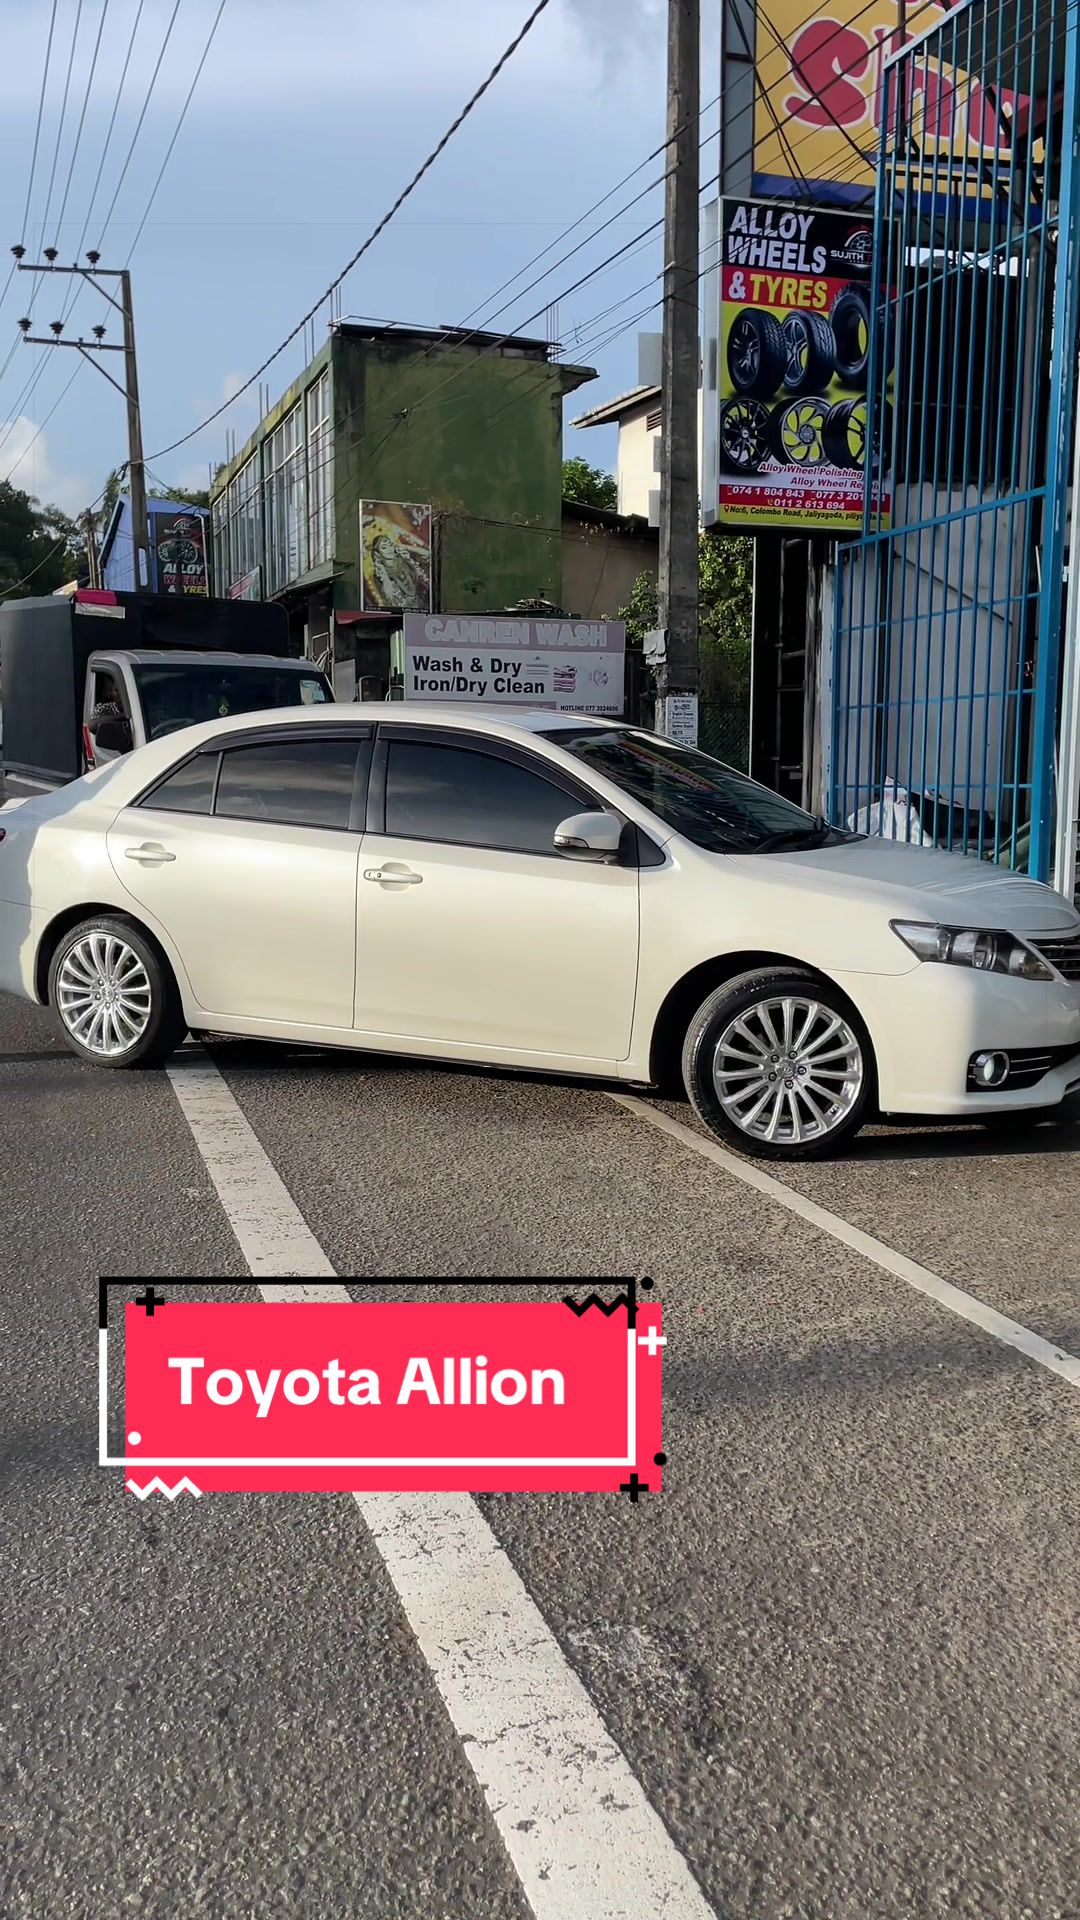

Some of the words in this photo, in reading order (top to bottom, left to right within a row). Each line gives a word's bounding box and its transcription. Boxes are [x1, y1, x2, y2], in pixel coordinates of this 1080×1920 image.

[729, 206, 815, 241] ALLOY
[728, 235, 827, 273] WHEELS
[830, 249, 864, 261] SUJITH
[728, 271, 746, 299] &
[750, 273, 828, 309] TYRES
[760, 462, 784, 474] Alloy
[786, 464, 817, 475] Wheel
[819, 467, 864, 480] Polishing
[790, 476, 815, 487] Alloy
[818, 479, 848, 488] Wheel
[732, 486, 752, 494] 074
[755, 487, 760, 495] 1
[764, 487, 783, 496] 804
[786, 489, 805, 497] 843
[816, 491, 835, 499] 077
[837, 492, 844, 500] 3
[751, 507, 781, 515] Colombo
[783, 509, 803, 518] Road,
[774, 498, 792, 506] 011
[805, 500, 824, 509] 613
[826, 502, 845, 510] 694
[536, 623, 607, 647] WASH
[412, 655, 463, 673] Wash
[470, 657, 483, 673] &
[490, 658, 522, 678] Dry
[413, 675, 488, 696] Iron/Dry
[493, 678, 545, 694] Clean
[560, 704, 584, 712] HOTLINE
